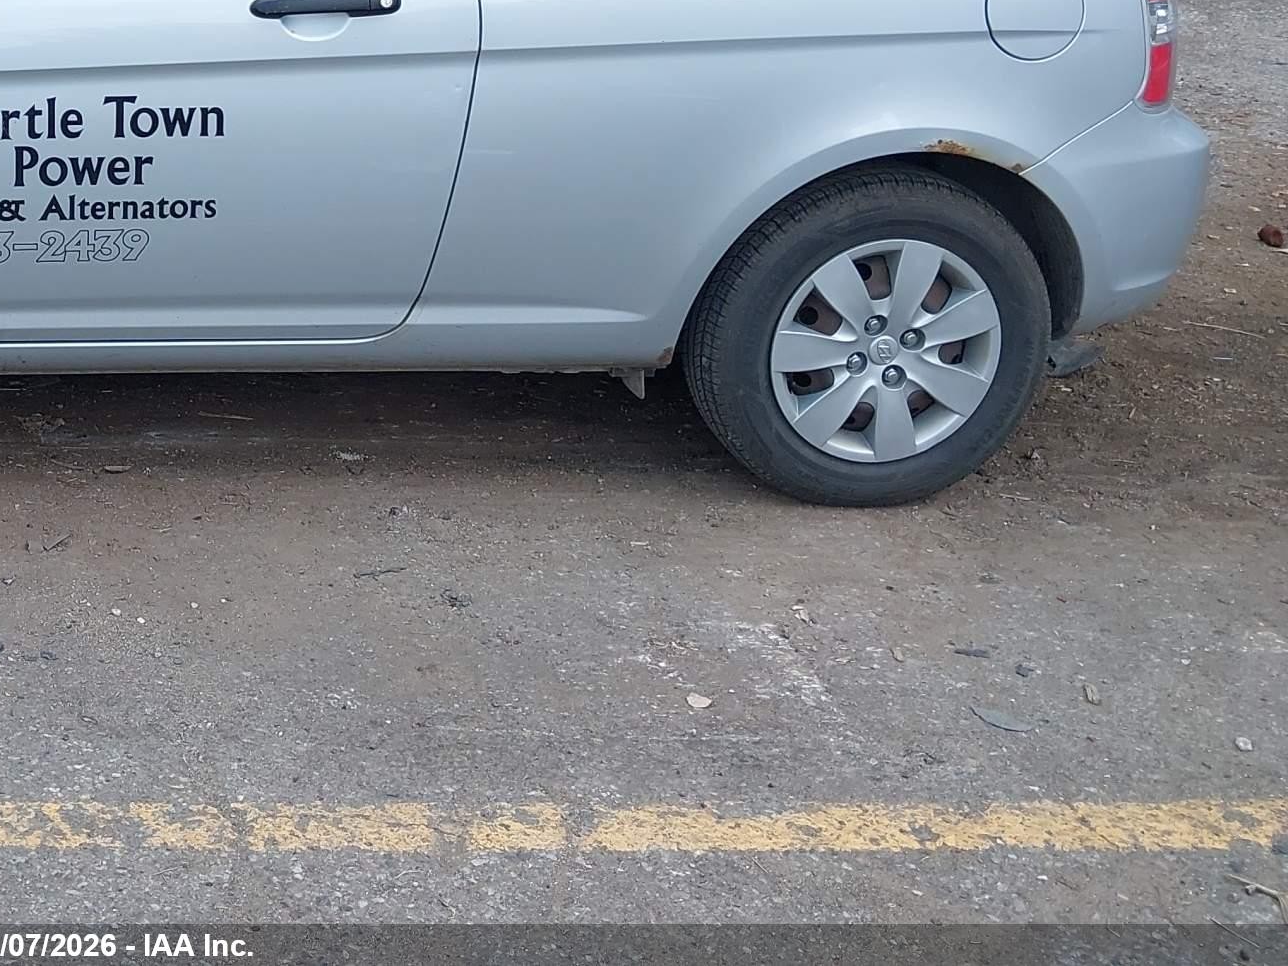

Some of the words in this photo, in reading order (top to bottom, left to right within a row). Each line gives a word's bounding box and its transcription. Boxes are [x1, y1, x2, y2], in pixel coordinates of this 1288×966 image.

[103, 95, 225, 138] Town
[13, 145, 154, 187] Power
[39, 194, 217, 221] Alternators
